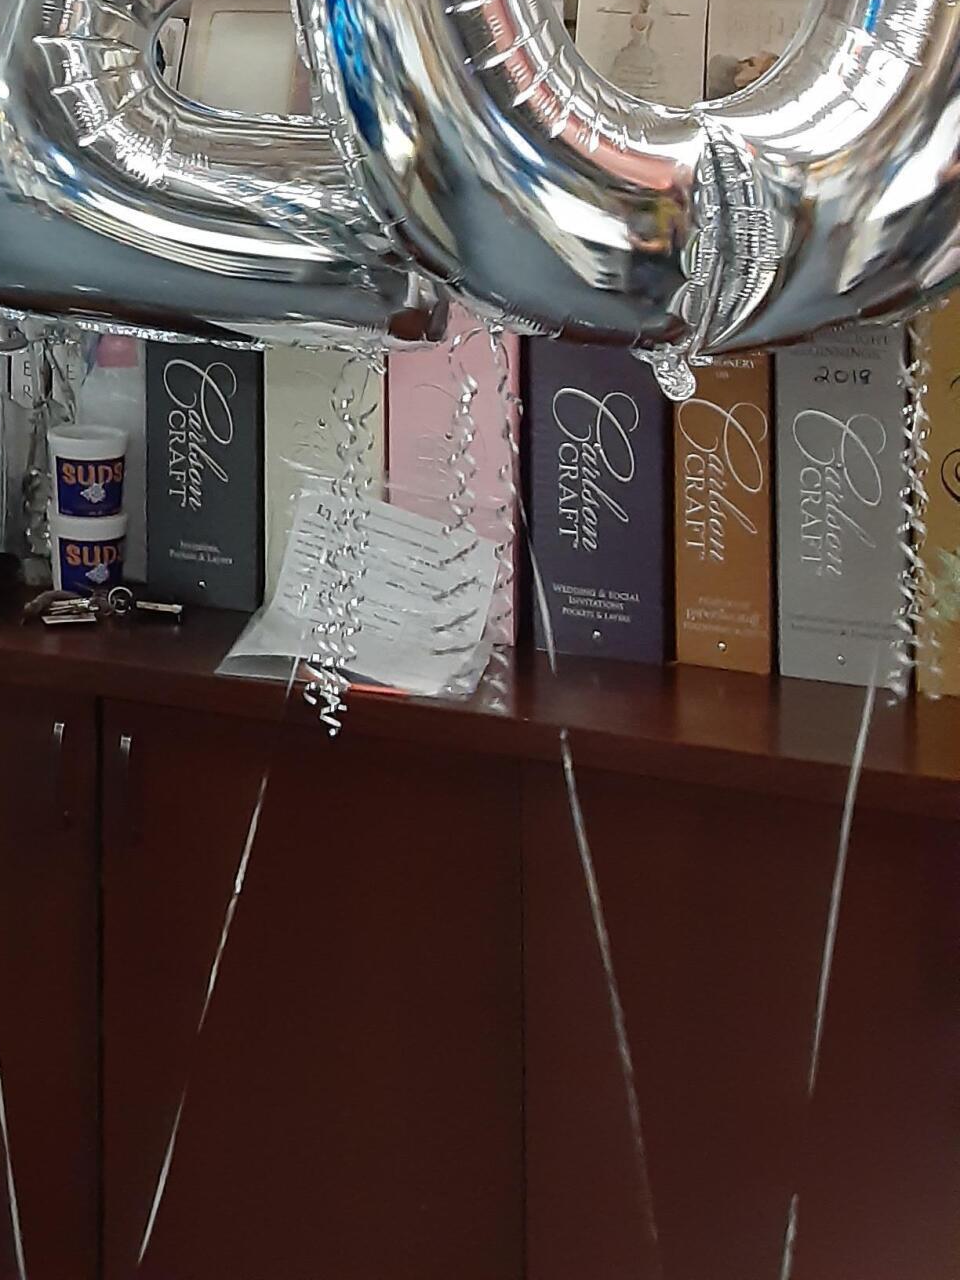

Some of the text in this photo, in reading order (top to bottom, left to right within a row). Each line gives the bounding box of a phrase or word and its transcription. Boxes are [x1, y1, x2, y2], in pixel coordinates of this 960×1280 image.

[62, 462, 123, 485] SUDS
[168, 410, 187, 507] CRAFT
[552, 387, 640, 551] Carlson
[558, 442, 579, 545] CRAFT
[678, 398, 768, 562] Carlson
[685, 453, 705, 556] CRAFT
[793, 409, 887, 577] Carlson
[66, 543, 121, 566] SUD
[800, 466, 822, 573] CRAFT
